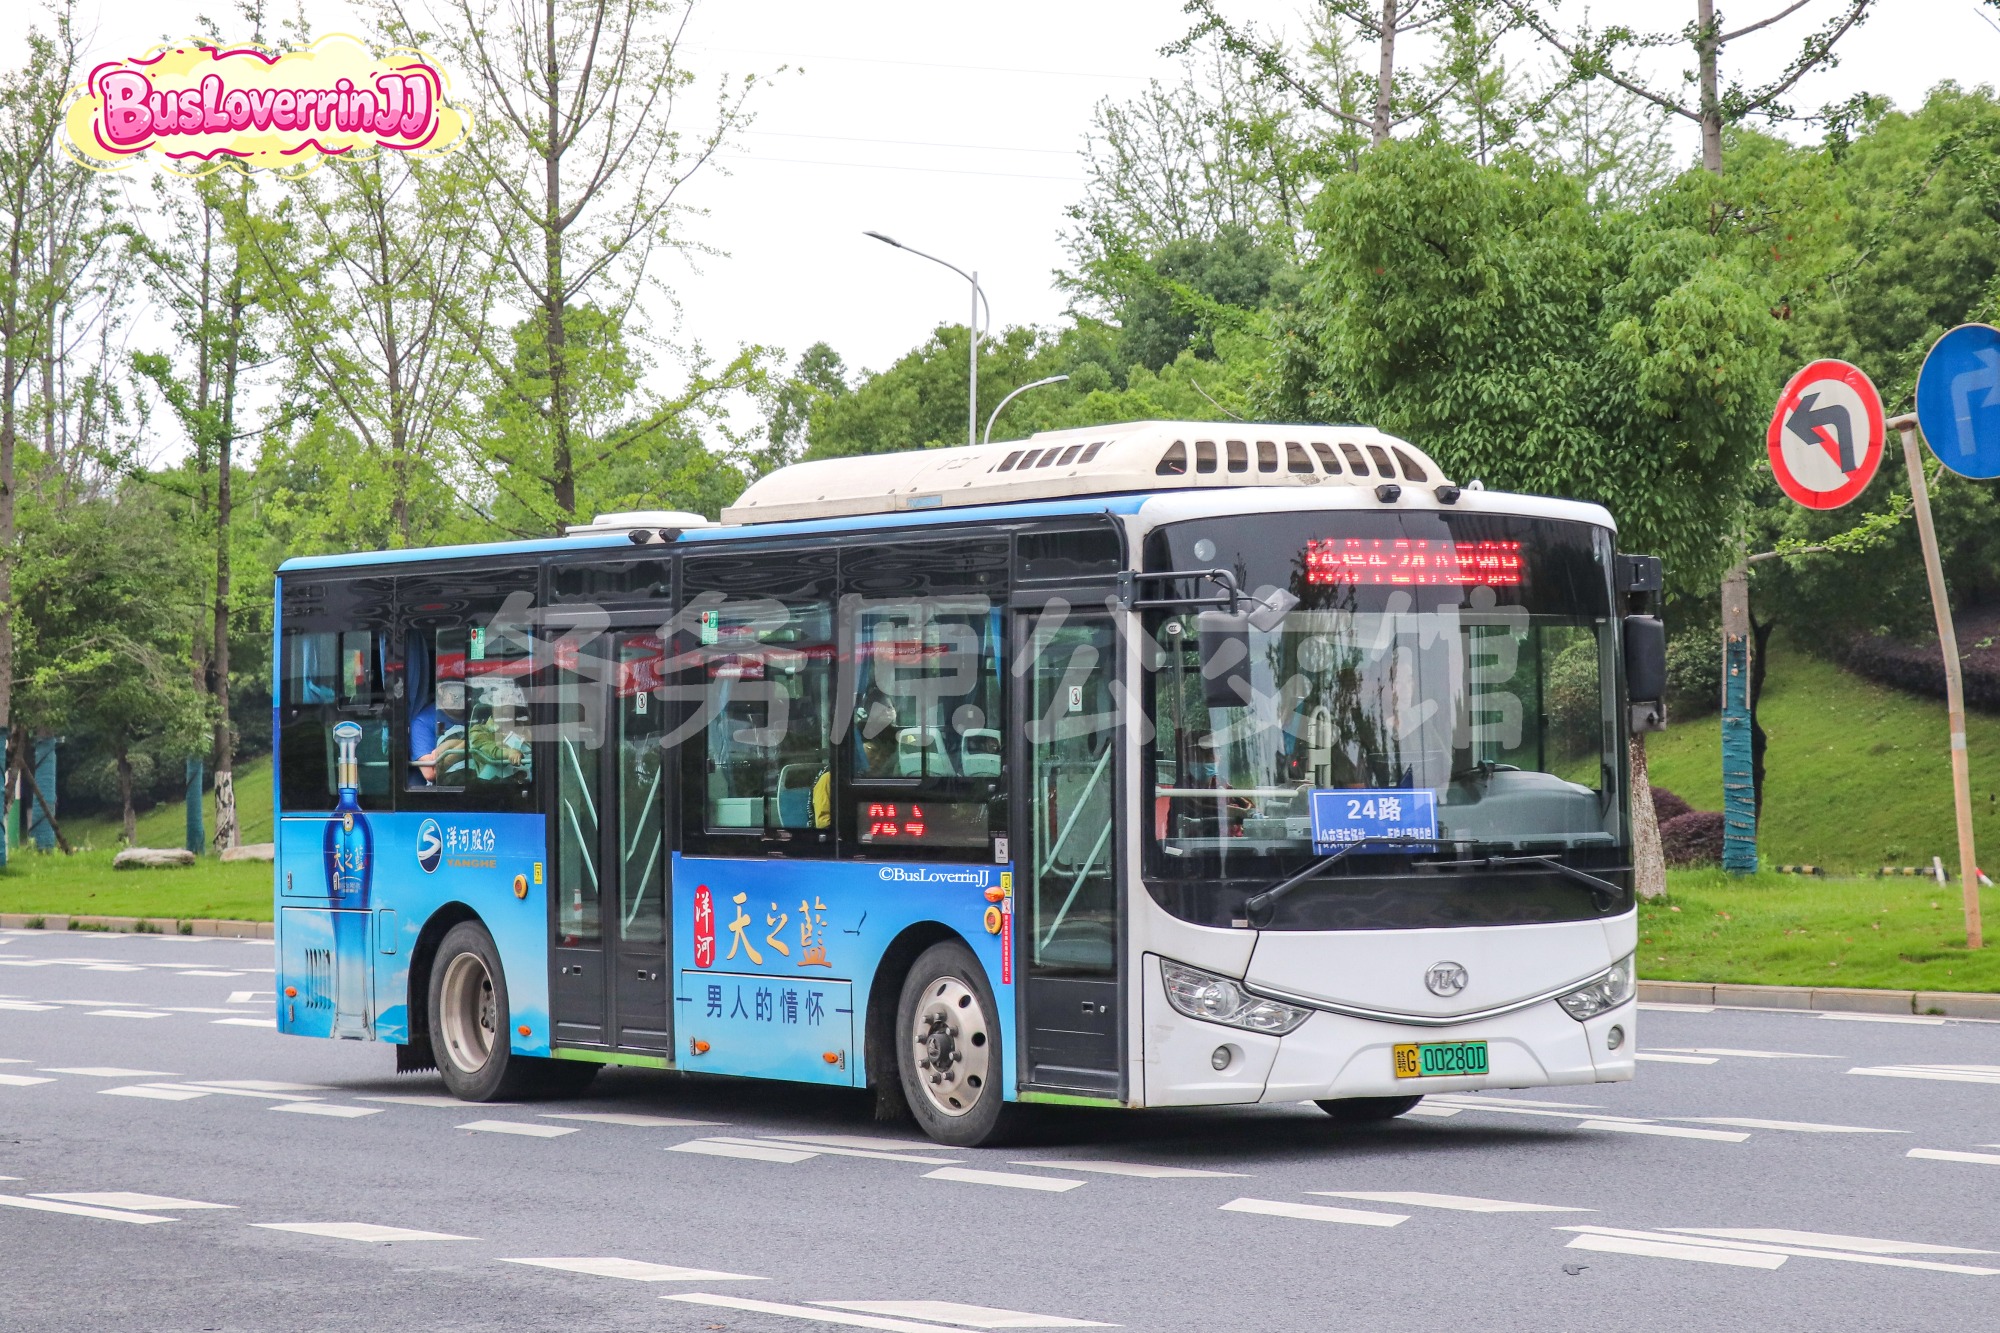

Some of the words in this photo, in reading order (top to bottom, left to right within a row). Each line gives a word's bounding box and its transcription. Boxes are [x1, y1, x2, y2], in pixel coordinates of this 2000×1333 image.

[1346, 796, 1402, 822] 24路
[446, 826, 496, 854] 洋河股份
[446, 858, 497, 869] YANGHE
[695, 891, 714, 966] 洋河
[1424, 1045, 1487, 1072] 00280D
